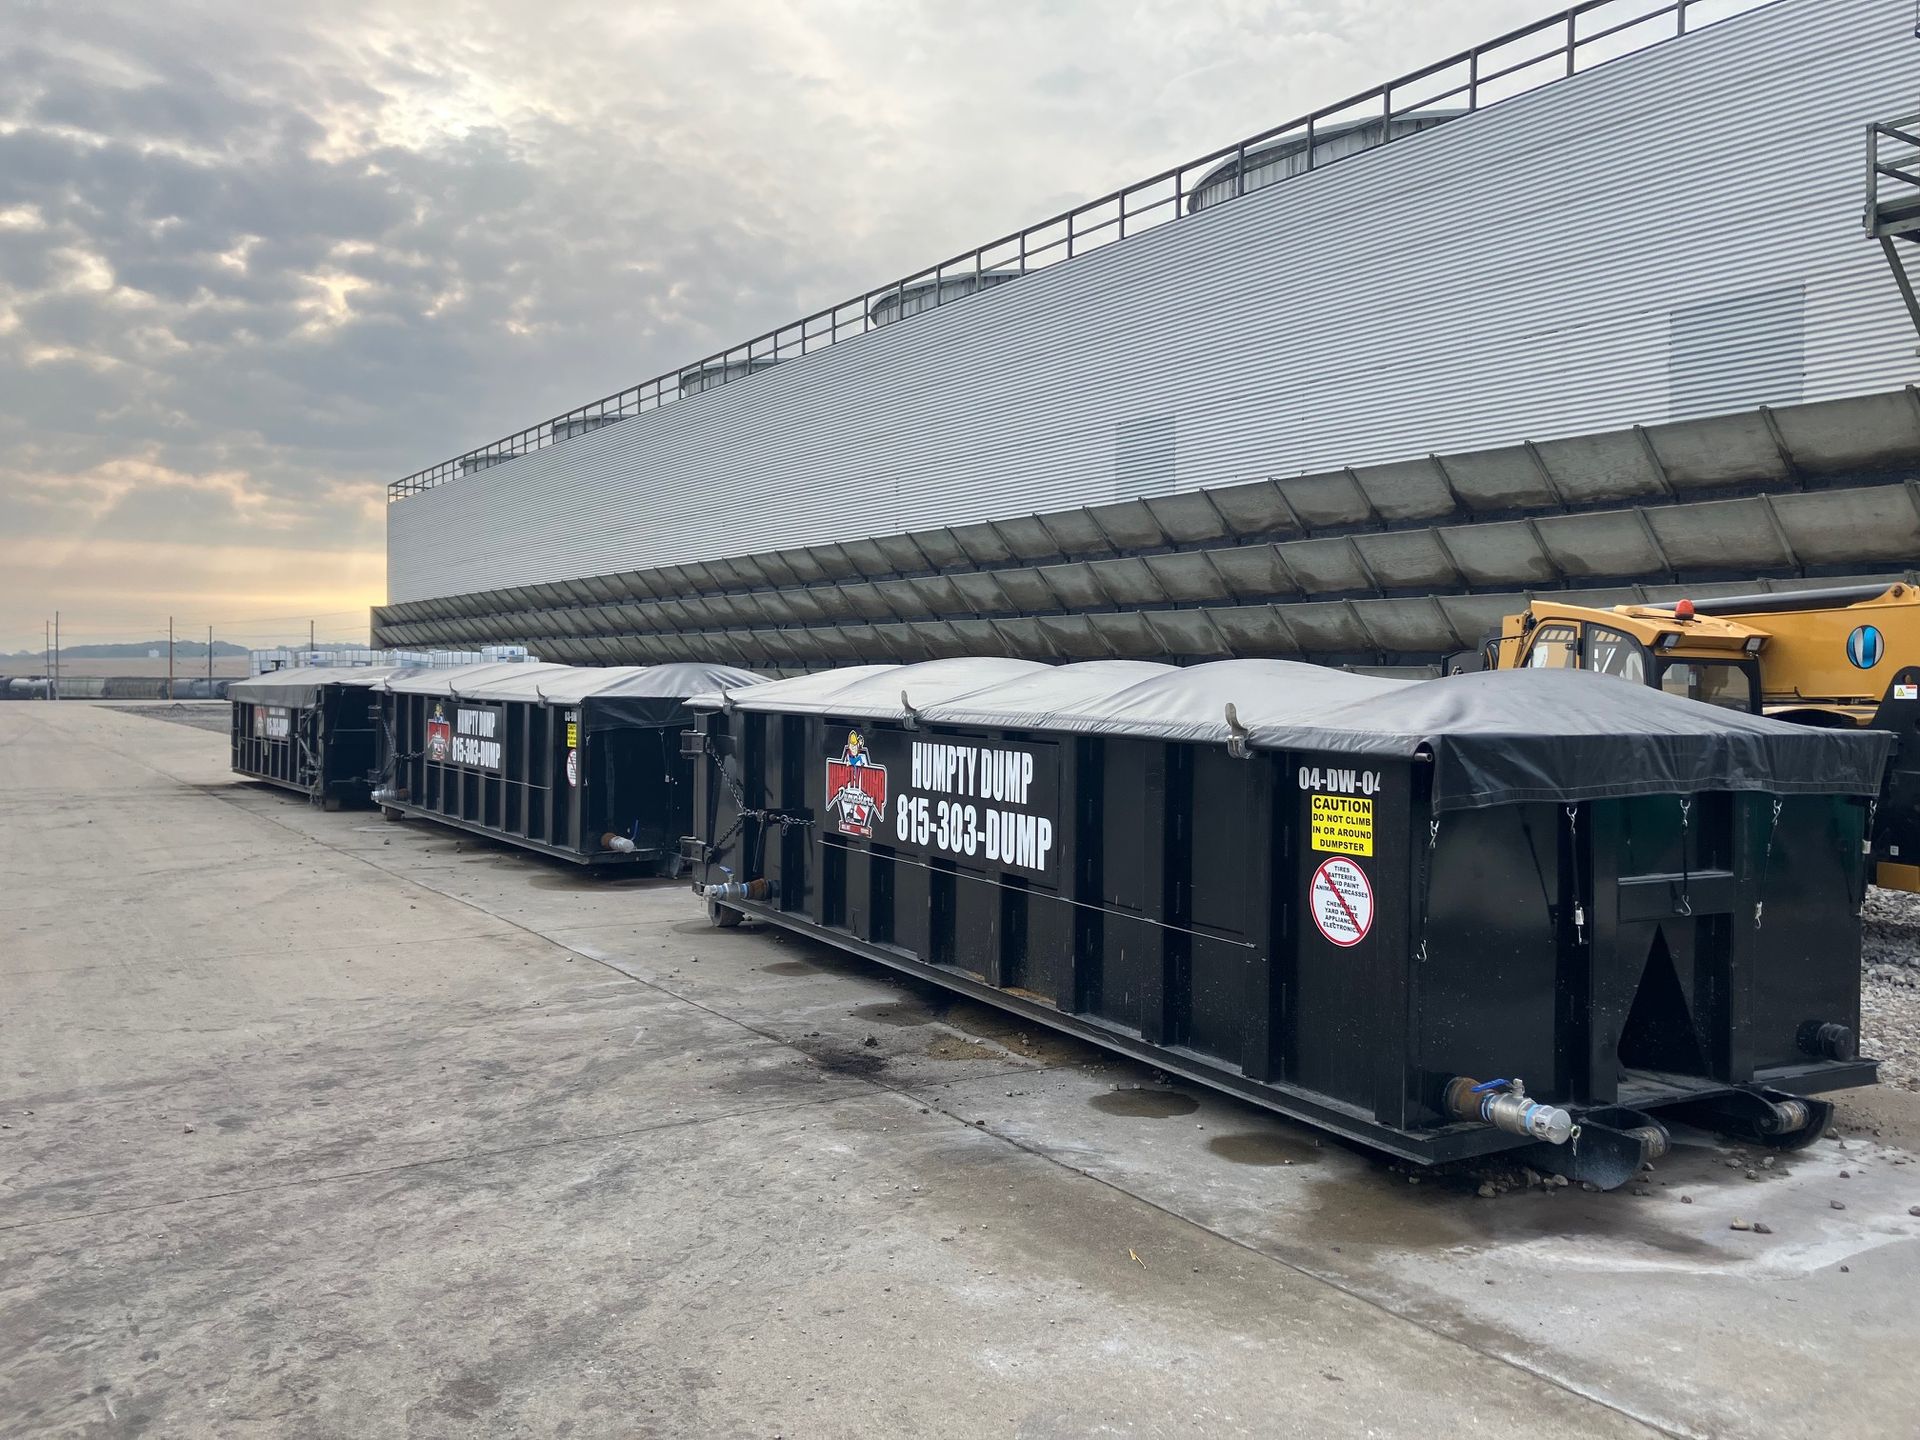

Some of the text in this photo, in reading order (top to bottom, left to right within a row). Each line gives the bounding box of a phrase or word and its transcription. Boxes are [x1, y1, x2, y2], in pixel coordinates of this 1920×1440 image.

[911, 741, 1033, 805] HUMPTY DUMP
[1298, 766, 1381, 795] 04-DW-04
[1313, 797, 1371, 814] CAUTION
[1313, 813, 1371, 826] DO NOT CLIMB
[896, 793, 1052, 871] 815-303-DUMP
[1312, 826, 1371, 839] IN OR AROUND
[1319, 839, 1364, 851] DUMPSTER
[1334, 865, 1350, 873] TIRES
[1328, 872, 1357, 881] BATTERIES
[1316, 884, 1336, 892] ANIMA
[1324, 879, 1343, 887] LUID
[1325, 907, 1339, 915] YARD
